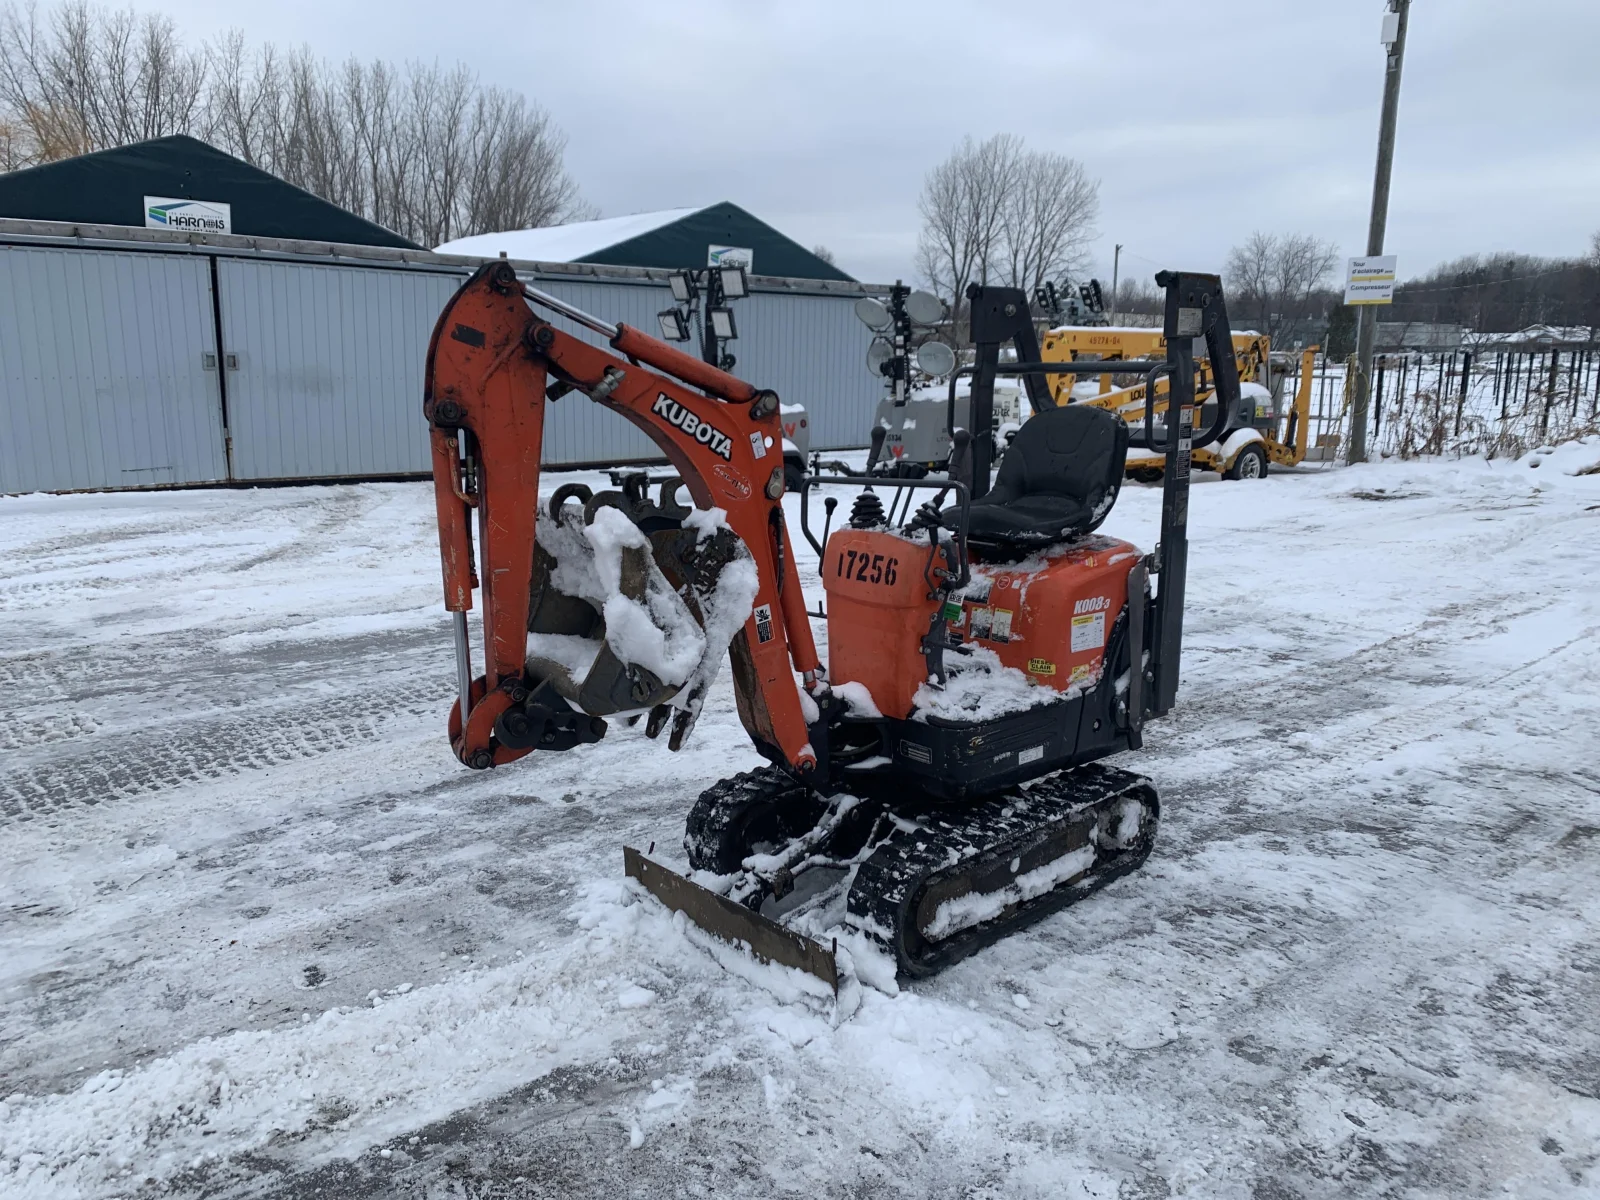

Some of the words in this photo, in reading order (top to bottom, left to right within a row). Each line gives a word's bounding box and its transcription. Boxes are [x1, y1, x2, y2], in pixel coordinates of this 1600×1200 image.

[169, 215, 225, 229] HARNOIS
[992, 408, 1010, 417] OU-TEC
[651, 392, 733, 461] KUBOTA
[838, 550, 898, 586] 17256
